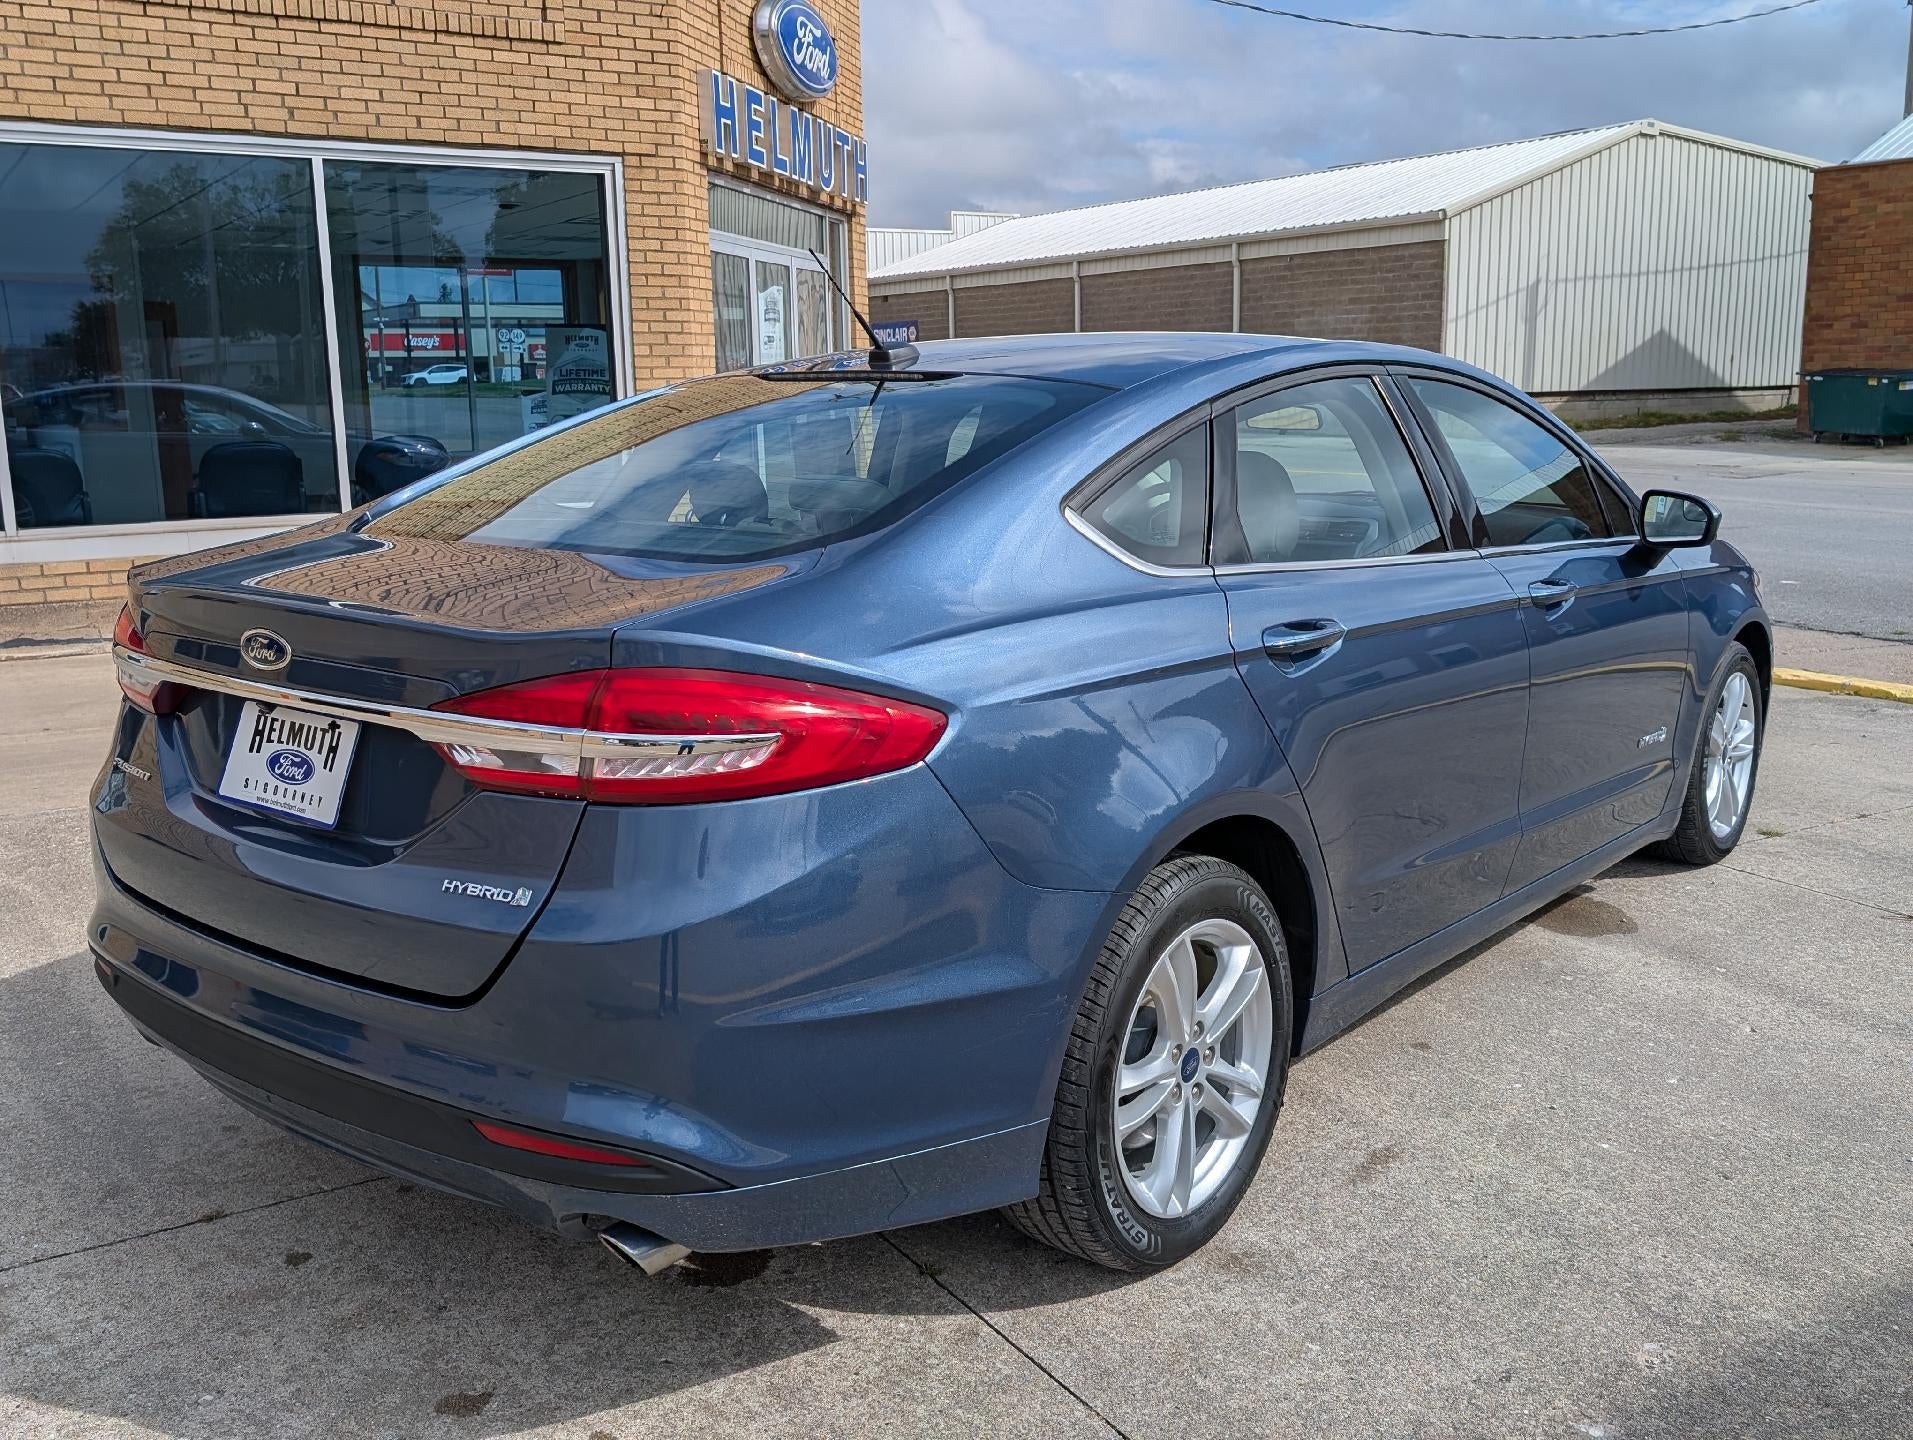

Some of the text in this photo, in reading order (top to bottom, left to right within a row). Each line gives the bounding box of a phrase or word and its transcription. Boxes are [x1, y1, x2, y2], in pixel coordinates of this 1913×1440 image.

[793, 16, 830, 80] Ford
[712, 69, 868, 204] HELMUTH
[500, 332, 509, 340] 92
[873, 328, 907, 342] SINCLAIR
[560, 368, 606, 378] LIFETIME
[555, 382, 610, 393] WARRANTY
[248, 636, 278, 661] Ford
[249, 711, 342, 773] HELMUTH
[275, 753, 308, 781] Ford
[243, 778, 323, 808] SIGOURNEY
[441, 879, 515, 902] HYBRID
